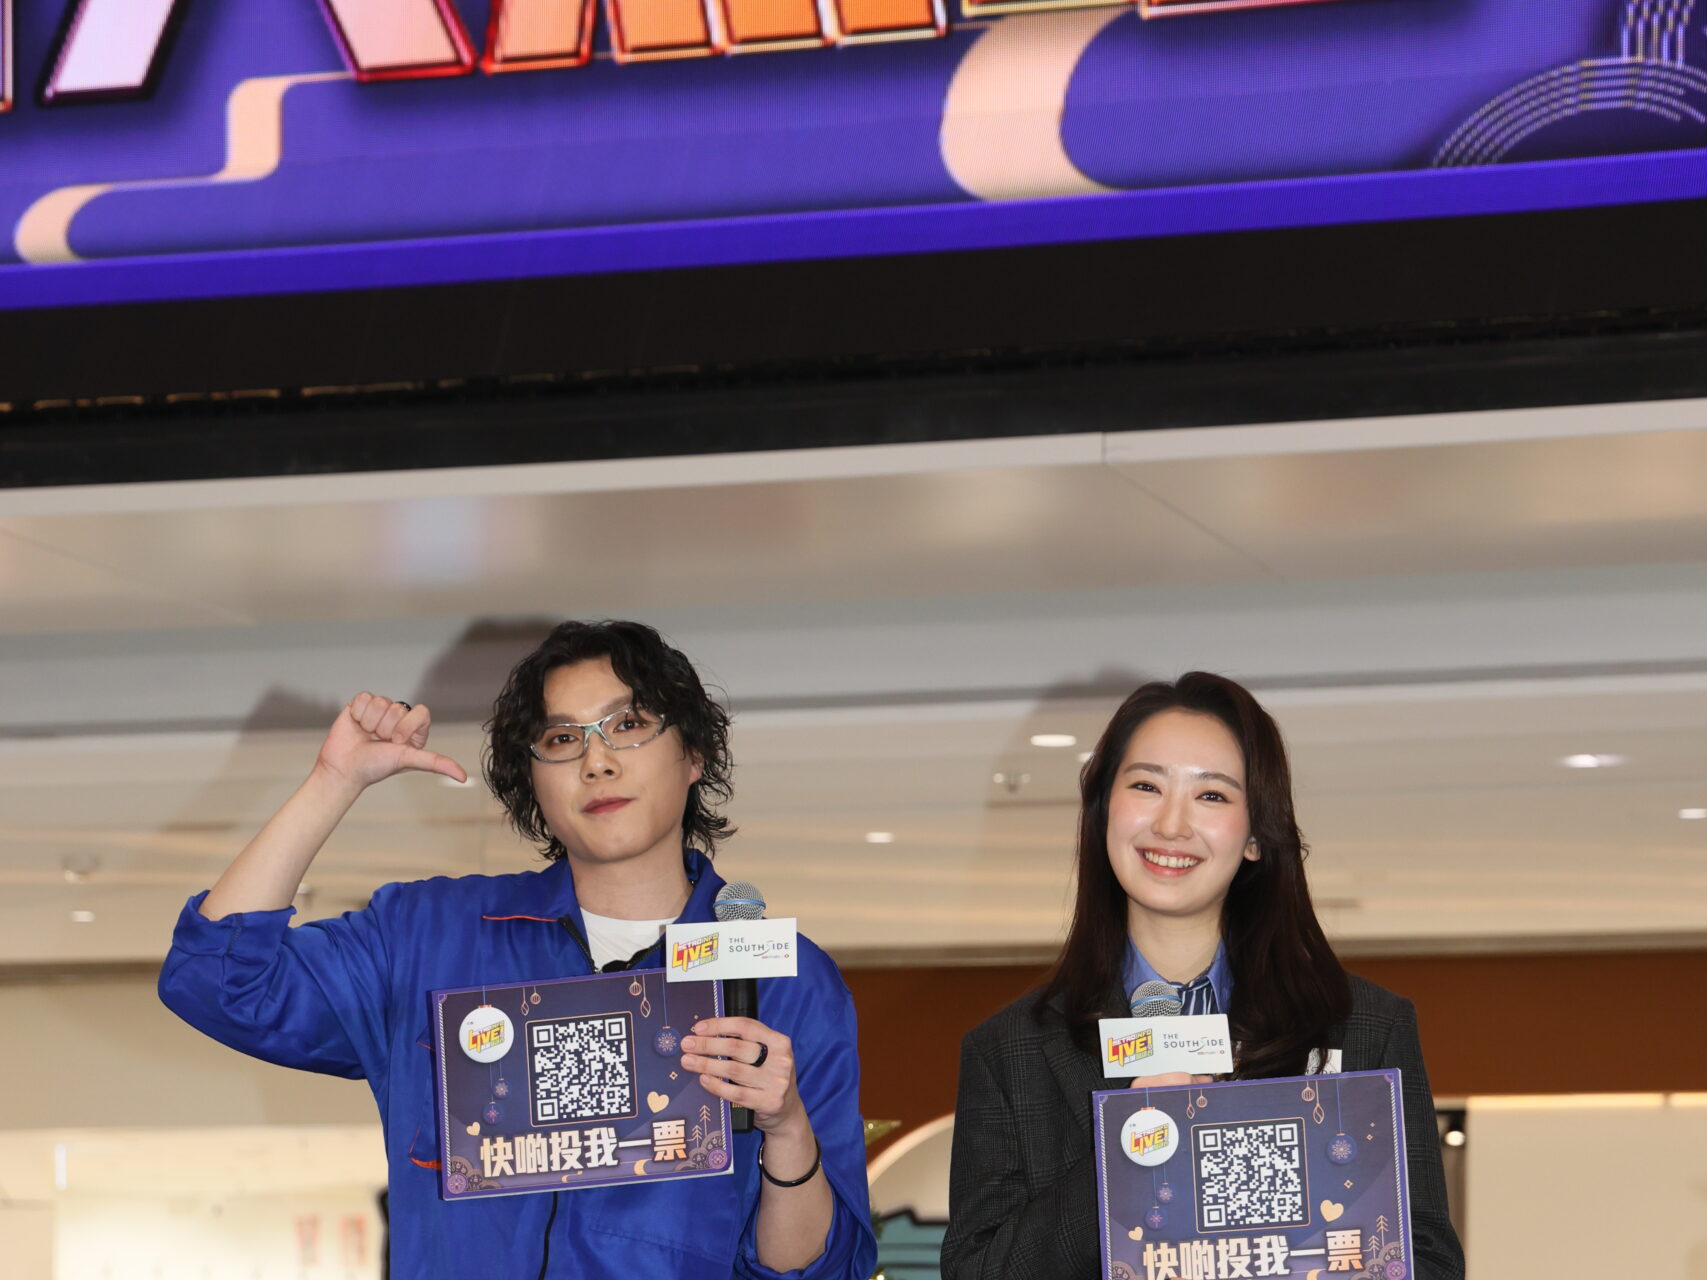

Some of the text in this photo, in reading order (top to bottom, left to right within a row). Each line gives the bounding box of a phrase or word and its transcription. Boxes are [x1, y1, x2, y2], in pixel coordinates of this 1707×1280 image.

[480, 1119, 687, 1178] 快啲投我一票
